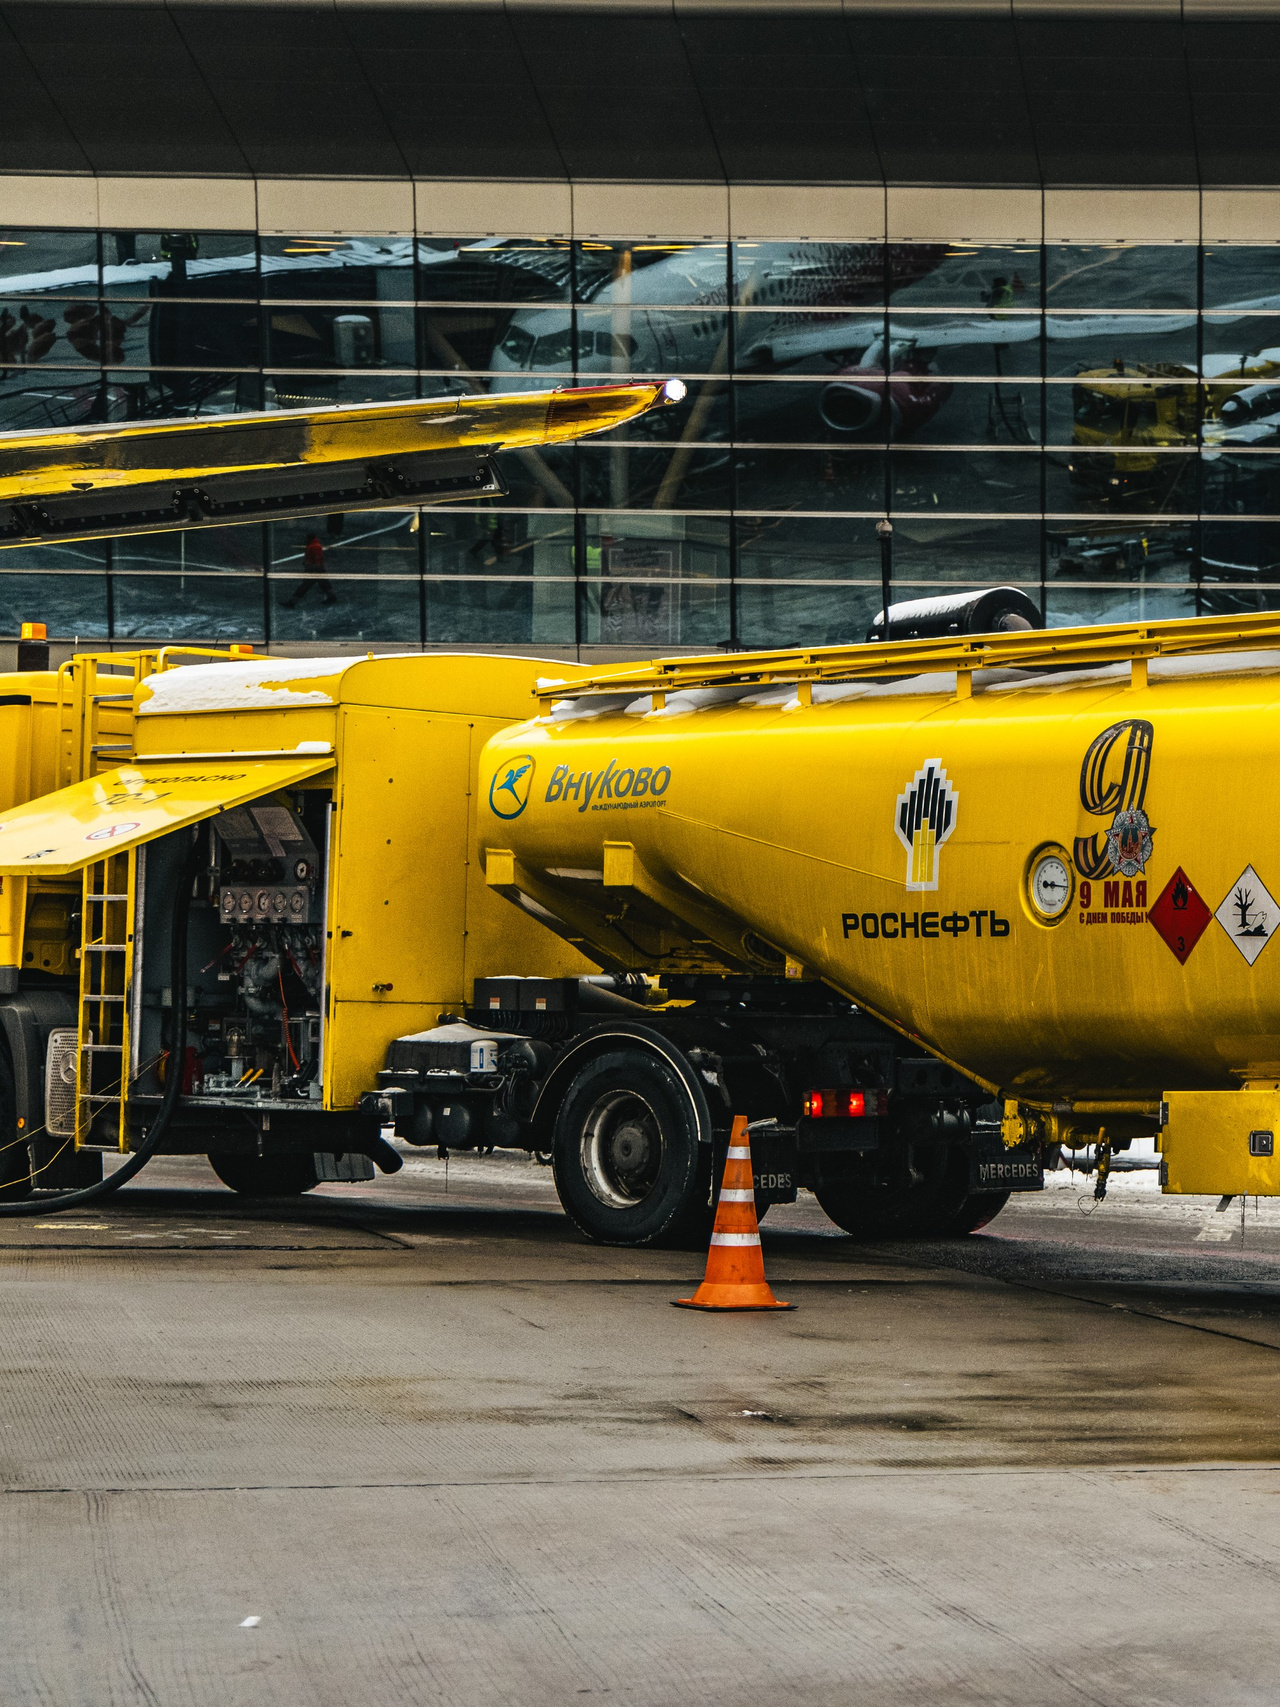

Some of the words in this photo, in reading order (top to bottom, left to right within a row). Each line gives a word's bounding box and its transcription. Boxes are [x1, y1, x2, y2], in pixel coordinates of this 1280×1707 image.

[545, 758, 671, 812] Внуково
[1079, 881, 1092, 908] 9
[1104, 880, 1147, 908] МАЯ
[842, 910, 1010, 939] РОСНЕФТЬ
[1178, 936, 1186, 952] 3
[753, 1173, 792, 1189] CEDES
[979, 1163, 1039, 1180] MERCEDES
